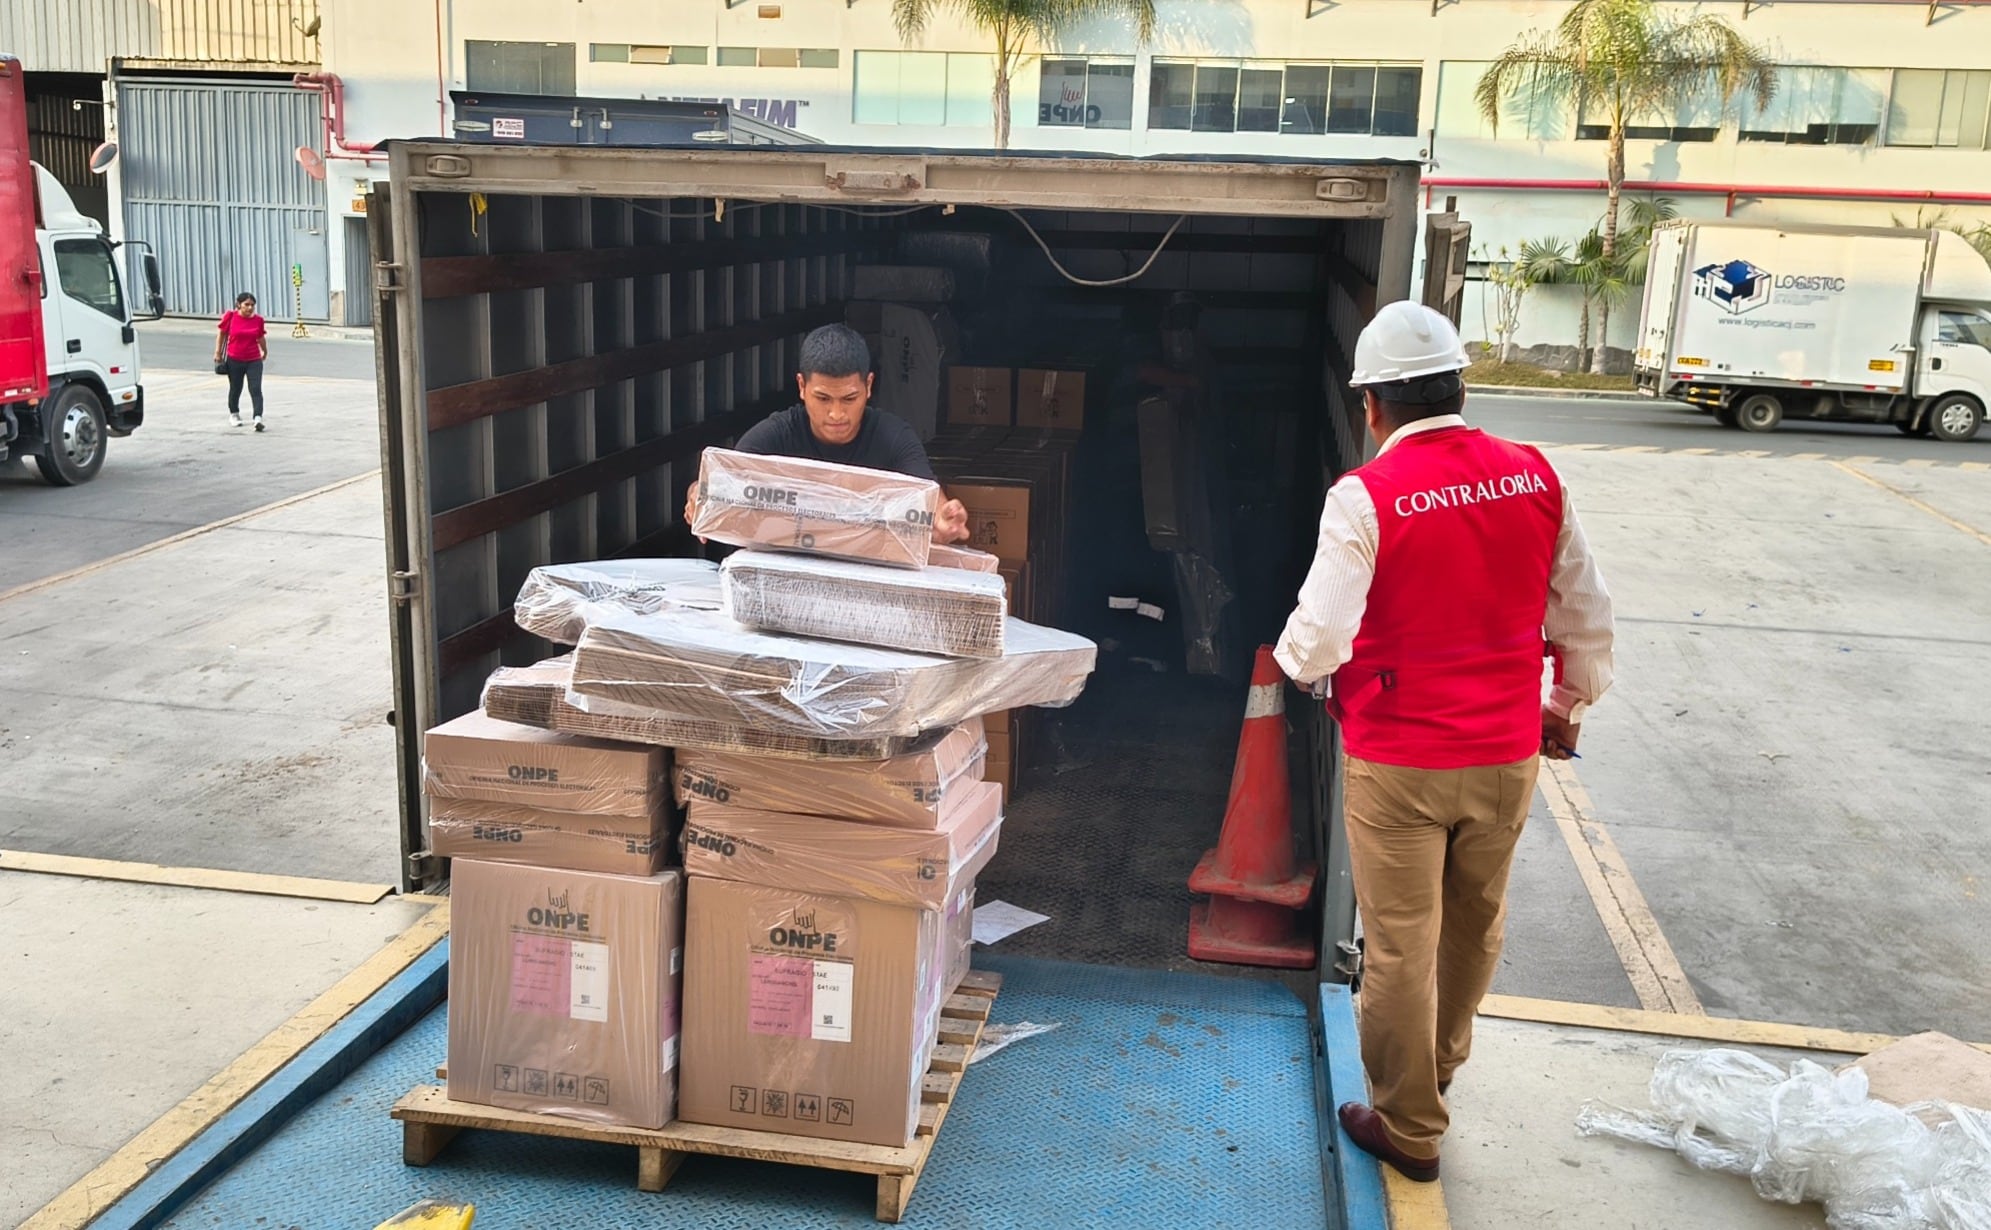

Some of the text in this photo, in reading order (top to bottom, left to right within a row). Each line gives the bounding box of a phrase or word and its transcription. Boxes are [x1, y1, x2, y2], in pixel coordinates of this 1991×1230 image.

[743, 485, 798, 506] ONPE
[1394, 468, 1548, 518] CONTRALORÍA
[507, 765, 559, 782] ONPE
[681, 774, 730, 803] ONPE
[473, 826, 523, 843] ONPE
[687, 829, 737, 858] ONPE
[527, 907, 590, 932] ONPE
[770, 927, 838, 953] ONPE
